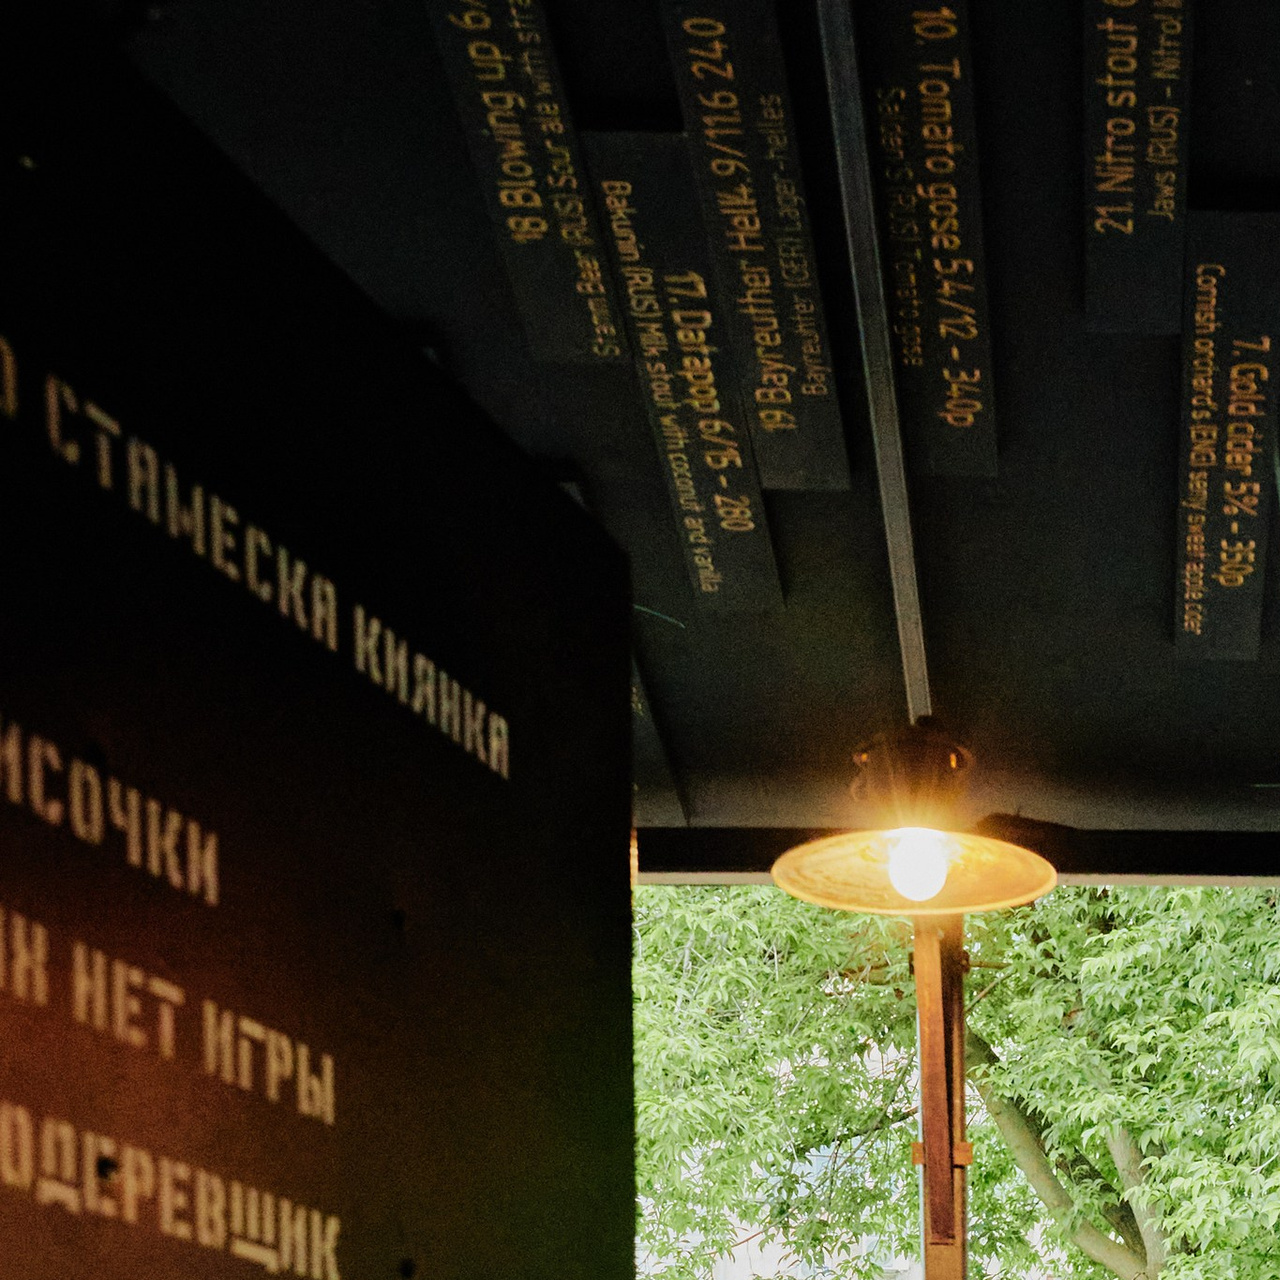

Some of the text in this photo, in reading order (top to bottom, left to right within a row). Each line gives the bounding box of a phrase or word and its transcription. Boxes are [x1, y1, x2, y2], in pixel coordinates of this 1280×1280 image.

[682, 17, 734, 80] 240
[912, 6, 958, 45] 10.
[467, 41, 510, 80] up
[1096, 17, 1137, 107] stout
[918, 58, 963, 173] Tomato
[1147, 106, 1180, 165] (RUS)
[481, 91, 542, 207] Blowing
[1095, 118, 1135, 192] Nitro
[601, 181, 644, 261] Bakunin
[773, 173, 805, 231] Lager
[916, 183, 961, 250] gose
[1147, 171, 1176, 221] Jaws
[622, 266, 661, 317] (RUS)
[1194, 264, 1226, 334] Cornish
[637, 323, 666, 357] Milk
[737, 259, 796, 403] Bayreuther
[645, 361, 680, 409] stout
[665, 271, 755, 531] 17. Datapop 6/15 280
[937, 368, 983, 427] 340p
[660, 414, 689, 450] with
[759, 409, 797, 432] 19
[668, 452, 705, 513] coconut
[1212, 335, 1271, 586] 7. Gold cider 5% 350p
[684, 516, 713, 544] and
[45, 373, 510, 779] СТАМЕСКА КИЯНКА
[0, 902, 334, 1126] Х НЕТ ИГРЫ
